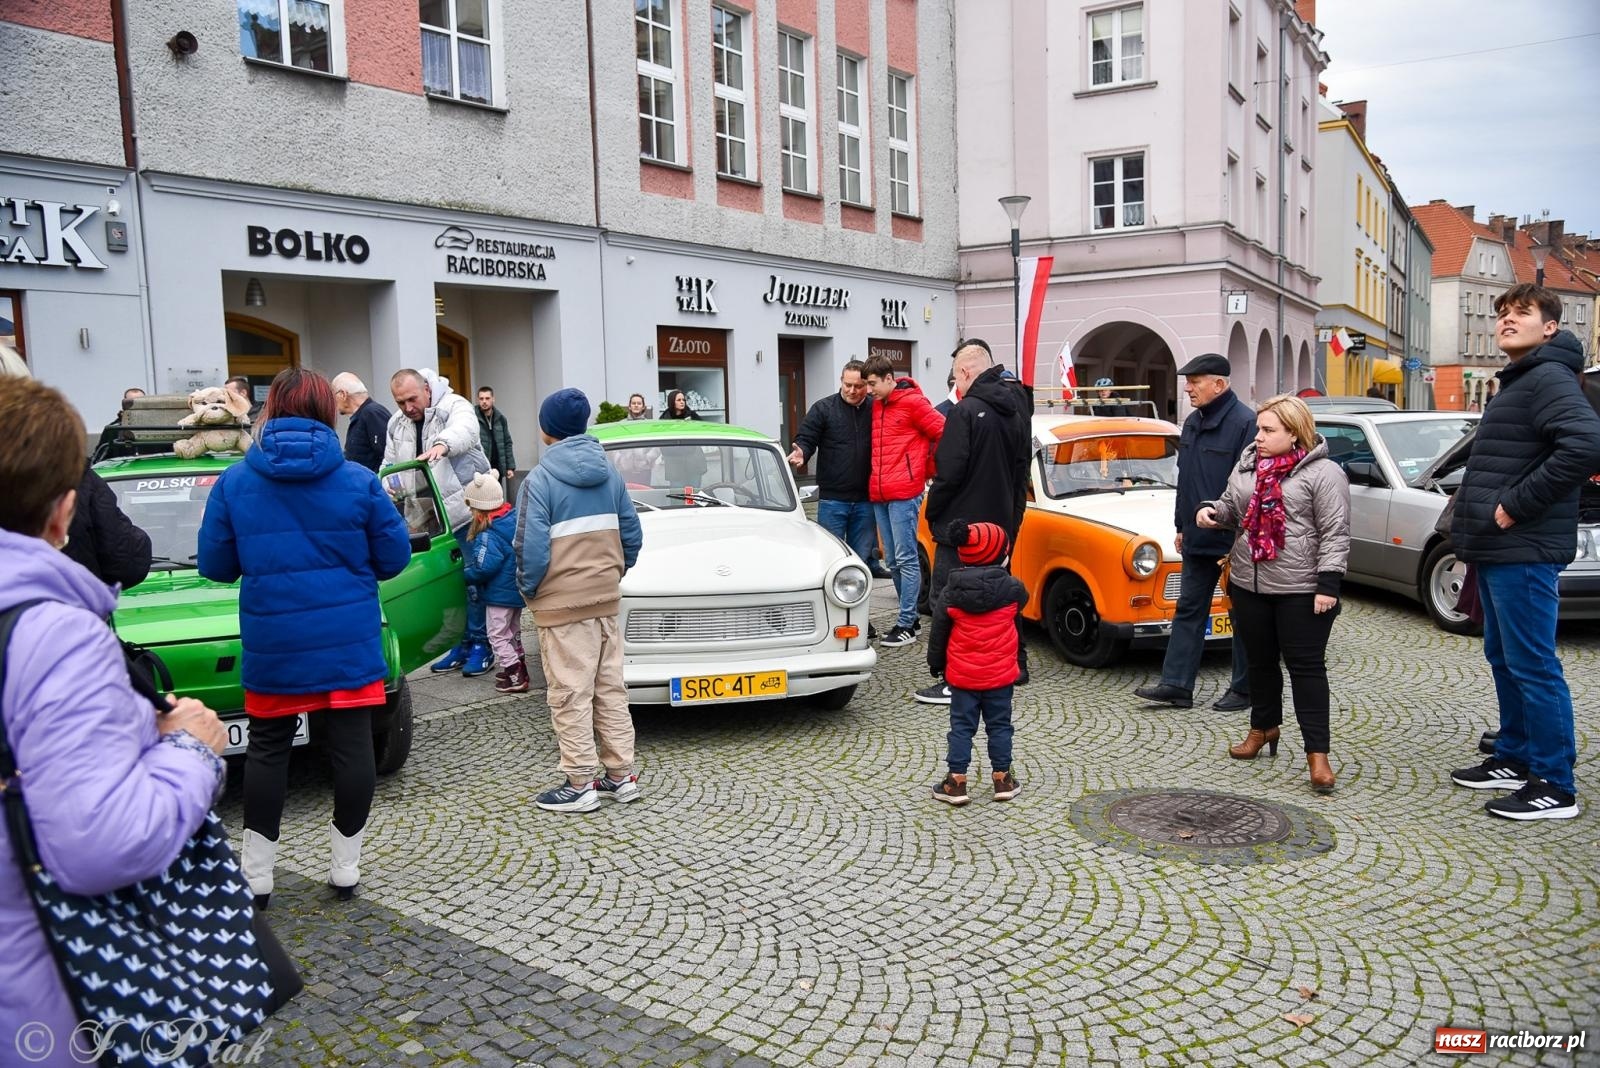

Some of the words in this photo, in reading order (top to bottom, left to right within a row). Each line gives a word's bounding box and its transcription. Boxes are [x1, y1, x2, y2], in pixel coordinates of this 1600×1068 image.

[247, 225, 370, 265] BOLKO
[476, 238, 556, 260] RESTAURACJA
[447, 254, 547, 281] RACIBORSKA
[764, 275, 852, 308] JUBILER
[669, 336, 711, 354] ZŁOTO
[136, 477, 196, 491] POLSKI
[685, 677, 724, 699] SRC
[732, 674, 756, 696] 4T
